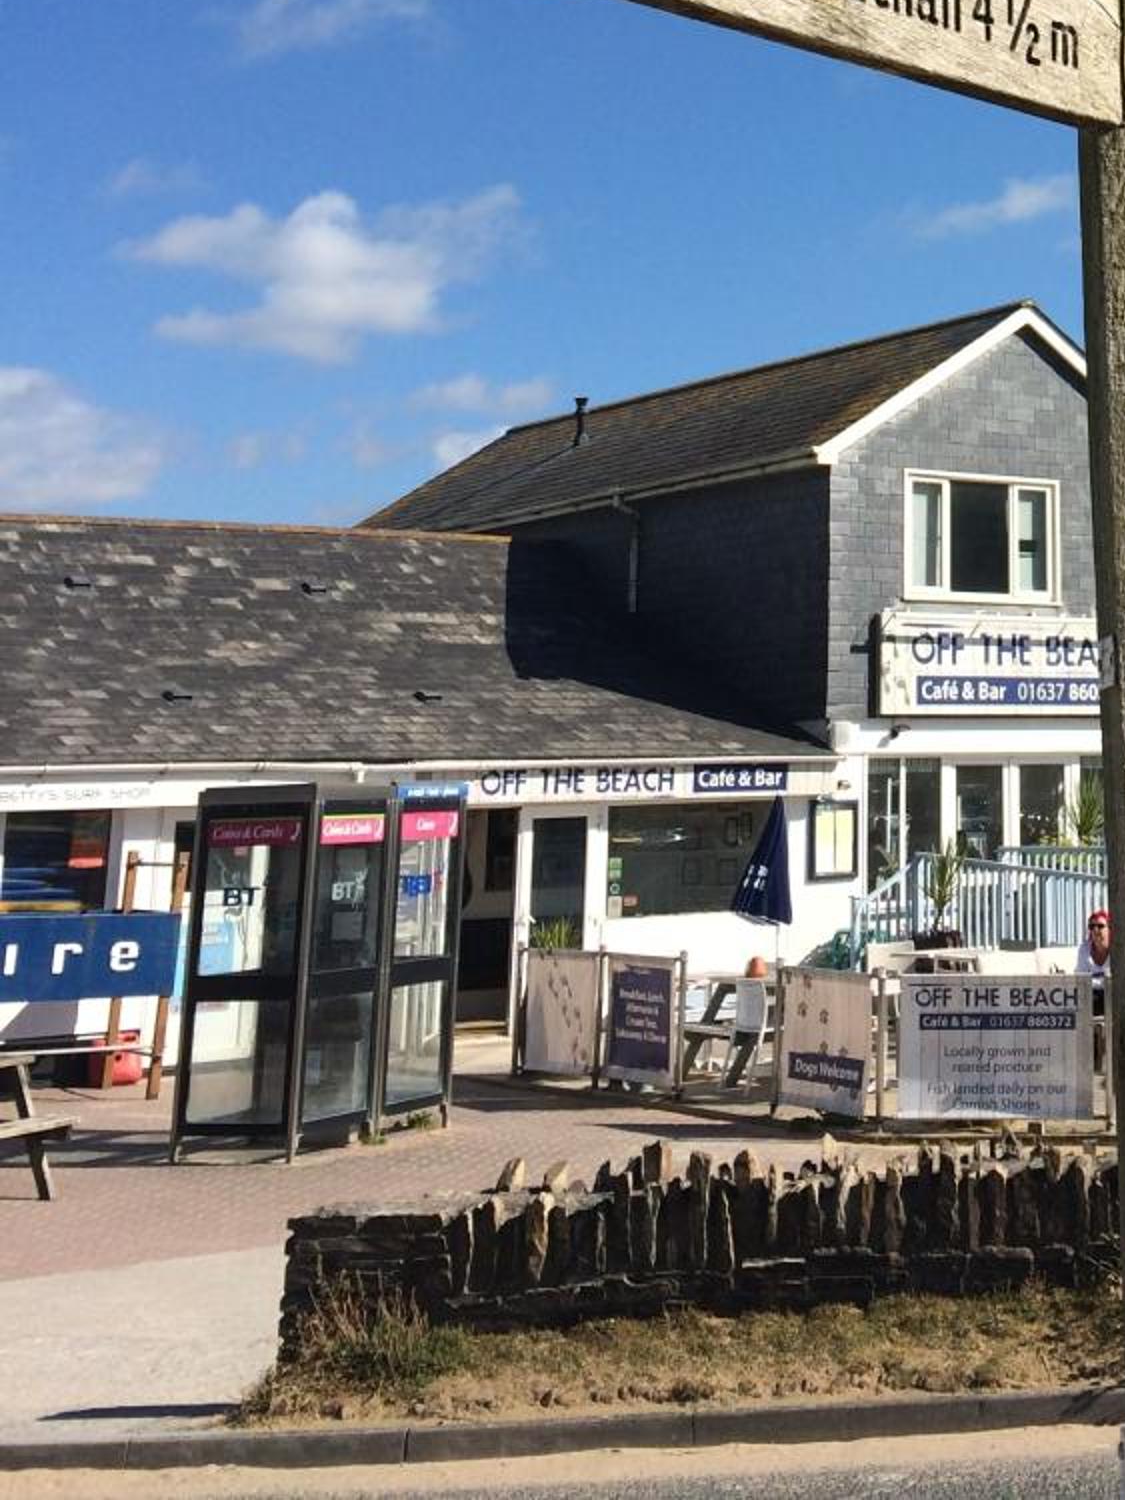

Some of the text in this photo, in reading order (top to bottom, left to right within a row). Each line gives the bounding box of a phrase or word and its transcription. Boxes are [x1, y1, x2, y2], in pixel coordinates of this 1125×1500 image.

[912, 632, 1098, 667] OFF THE BEA
[921, 679, 1098, 701] Café & Bar 01637 860
[481, 766, 783, 795] OFF THE BEACH Café & Bar
[224, 888, 264, 906] BT
[331, 882, 354, 900] BT
[915, 987, 1078, 1007] OFF THE BEACH
[922, 1014, 1072, 1028] Café & Bar 01637 860372
[944, 1045, 1051, 1061] Locally grown and
[795, 1059, 818, 1077] Dogs
[993, 1062, 1043, 1075] produce
[954, 1082, 994, 1095] landed
[999, 1082, 1023, 1098] daily
